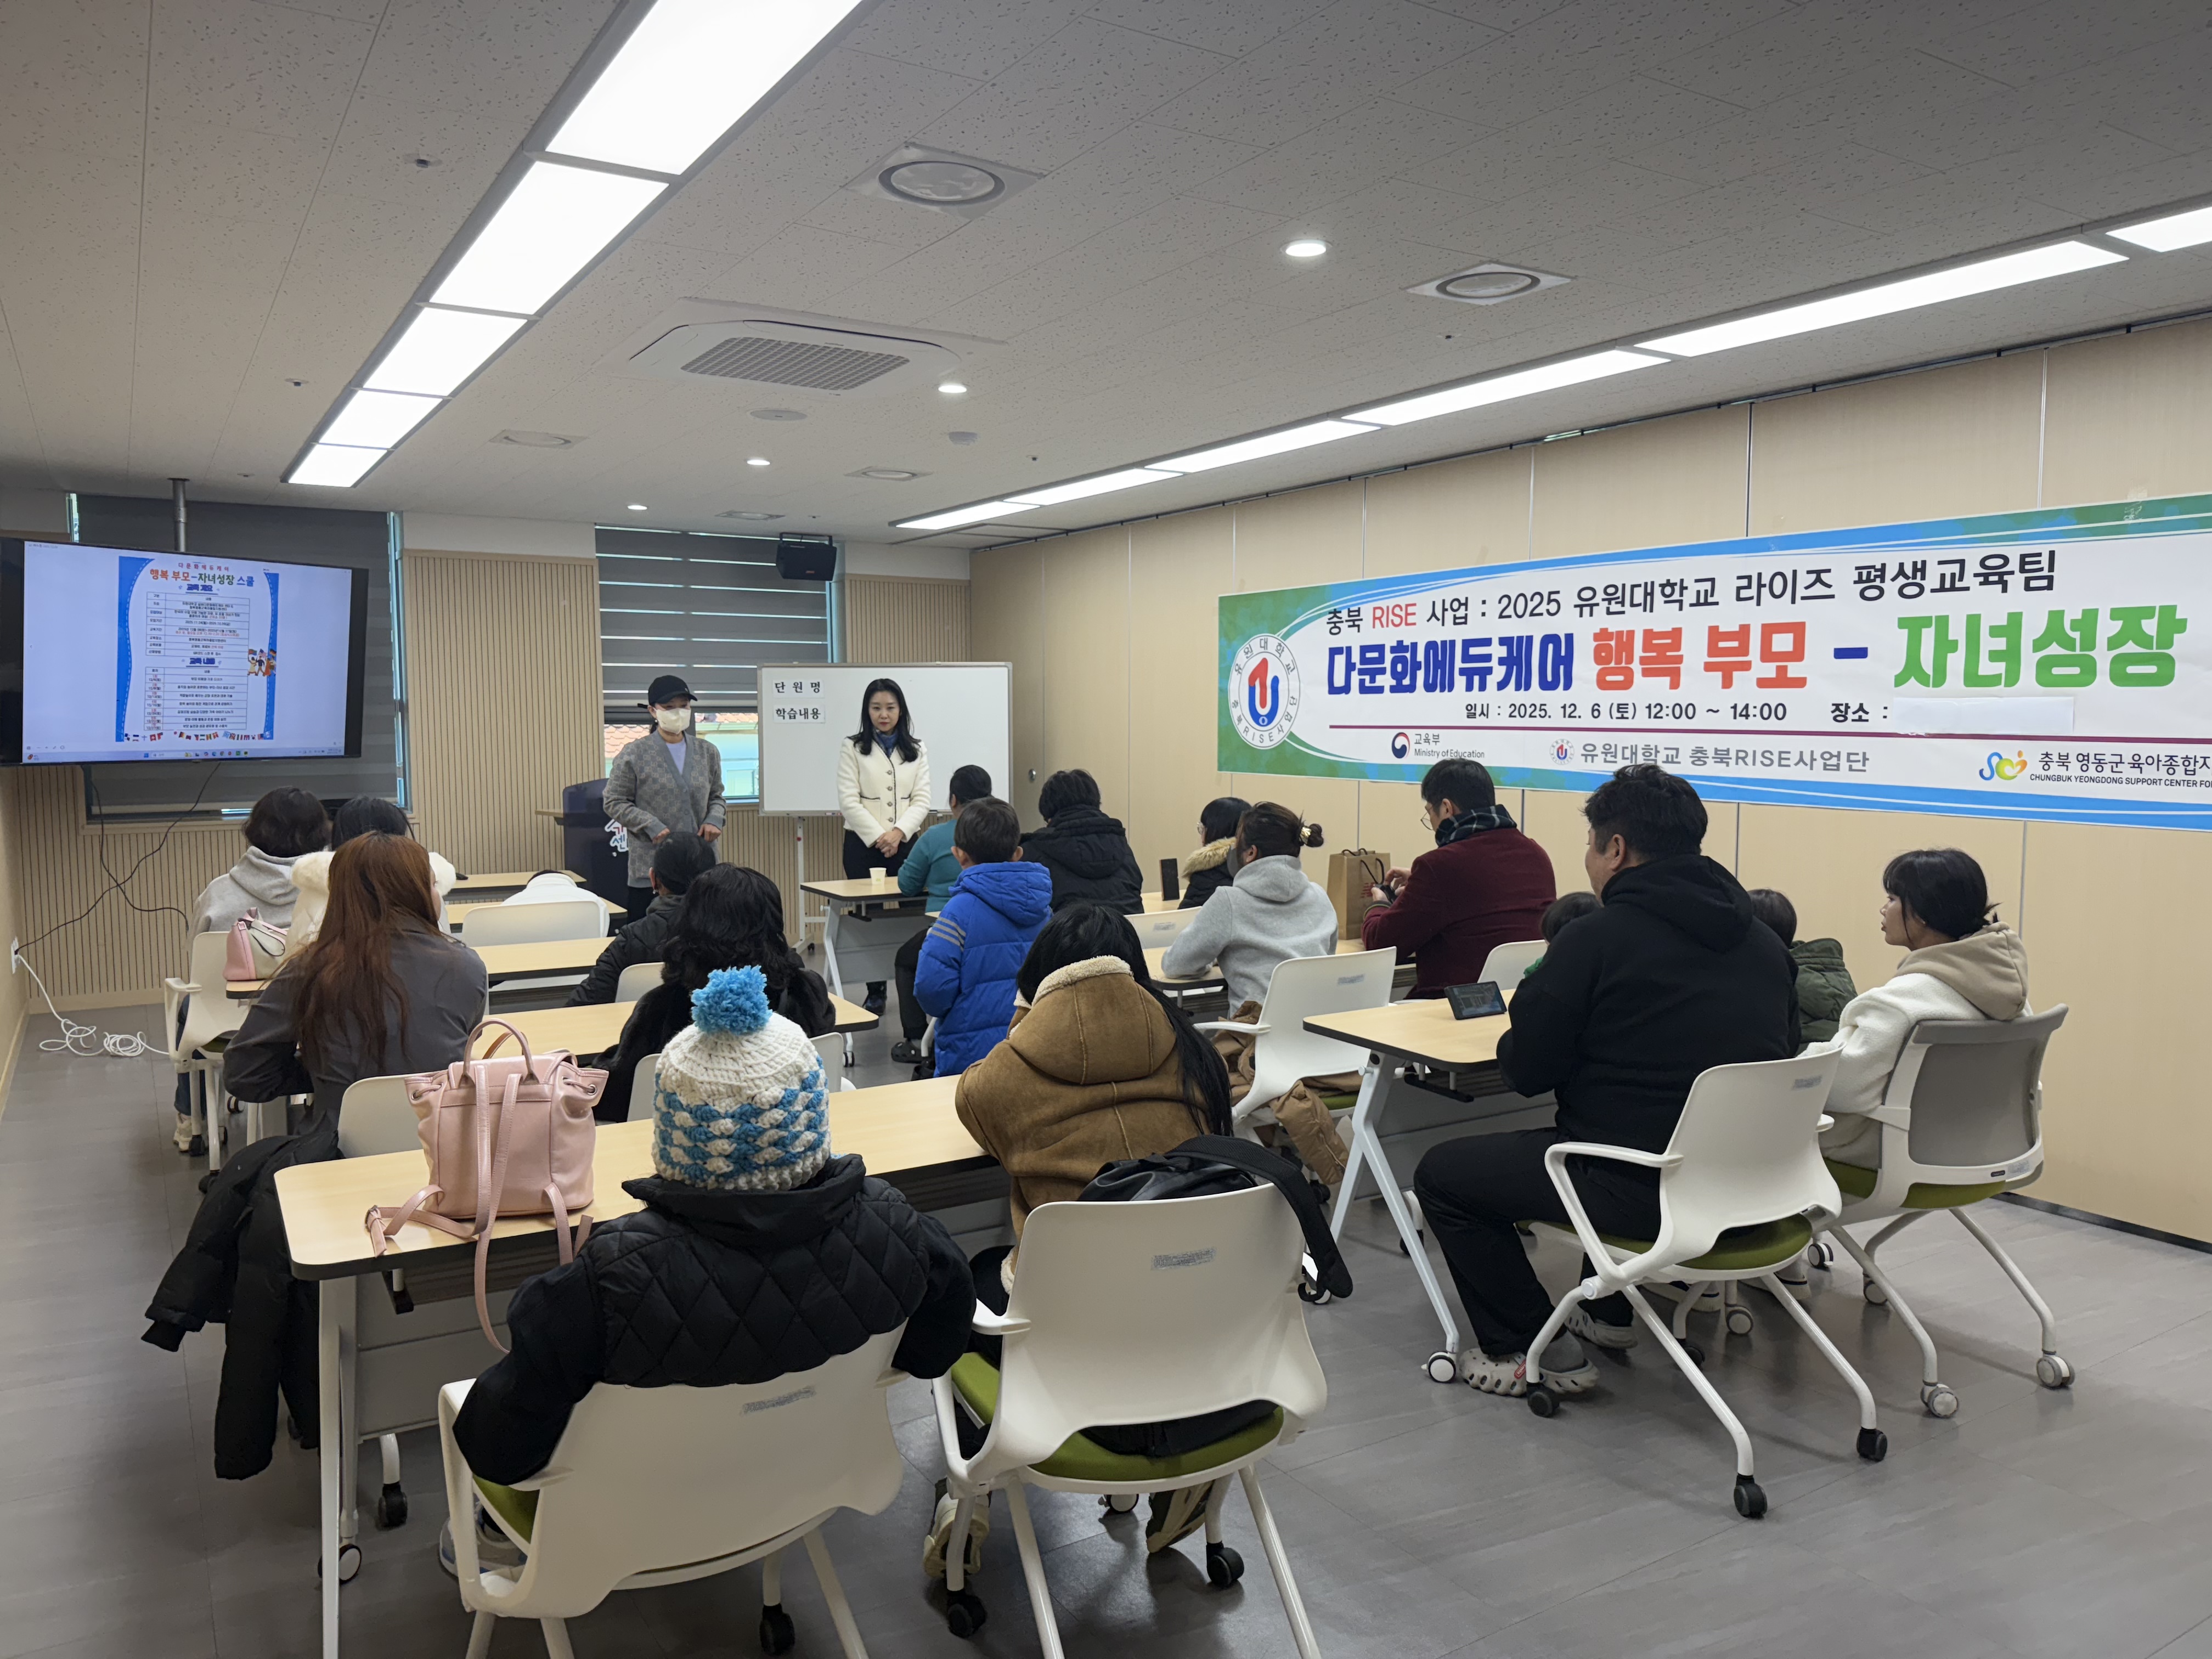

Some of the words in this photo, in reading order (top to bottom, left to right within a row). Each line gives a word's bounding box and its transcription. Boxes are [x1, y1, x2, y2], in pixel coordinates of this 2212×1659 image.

[150, 568, 169, 580] 행복
[236, 575, 255, 587] 스쿨
[1326, 607, 1363, 635] 충북
[1372, 602, 1417, 629] RISE
[1426, 596, 1469, 627] 사업
[1497, 590, 1561, 619] 2025
[1573, 577, 1720, 618] 유원대학교
[1735, 568, 1836, 607] 라이즈
[1853, 550, 2057, 602] 평생교육팀
[1234, 637, 1296, 675] 유원대학교
[1327, 632, 1574, 696] 다문화에듀케어
[1592, 627, 1684, 691] 행복
[1703, 620, 1808, 690] 부모
[1894, 604, 2188, 689] 자녀성장
[775, 708, 821, 720] 학습내용
[1464, 703, 1489, 720] 일시
[1508, 703, 1551, 719] 2025.
[1560, 703, 1582, 719] 12.
[1590, 703, 1601, 719] 6
[1609, 702, 1637, 720] (토)
[1644, 702, 1696, 720] 12:00
[1729, 702, 1787, 721] 14:00
[1831, 702, 1870, 723] 장소
[1414, 733, 1440, 746] 교육부
[1414, 748, 1440, 759] Ministry
[1441, 748, 1449, 757] of
[1450, 749, 1485, 759] Education
[1581, 743, 1681, 765] 유원대학교
[1689, 746, 1870, 772] 충북RISE사업단
[2039, 751, 2072, 771] 충북
[2076, 752, 2125, 774] 영동군
[2029, 774, 2073, 783] CHUNGBUK
[2074, 775, 2124, 785] YEONGDONG
[2125, 777, 2163, 786] SUPPORT
[2164, 778, 2198, 788] CENTER
